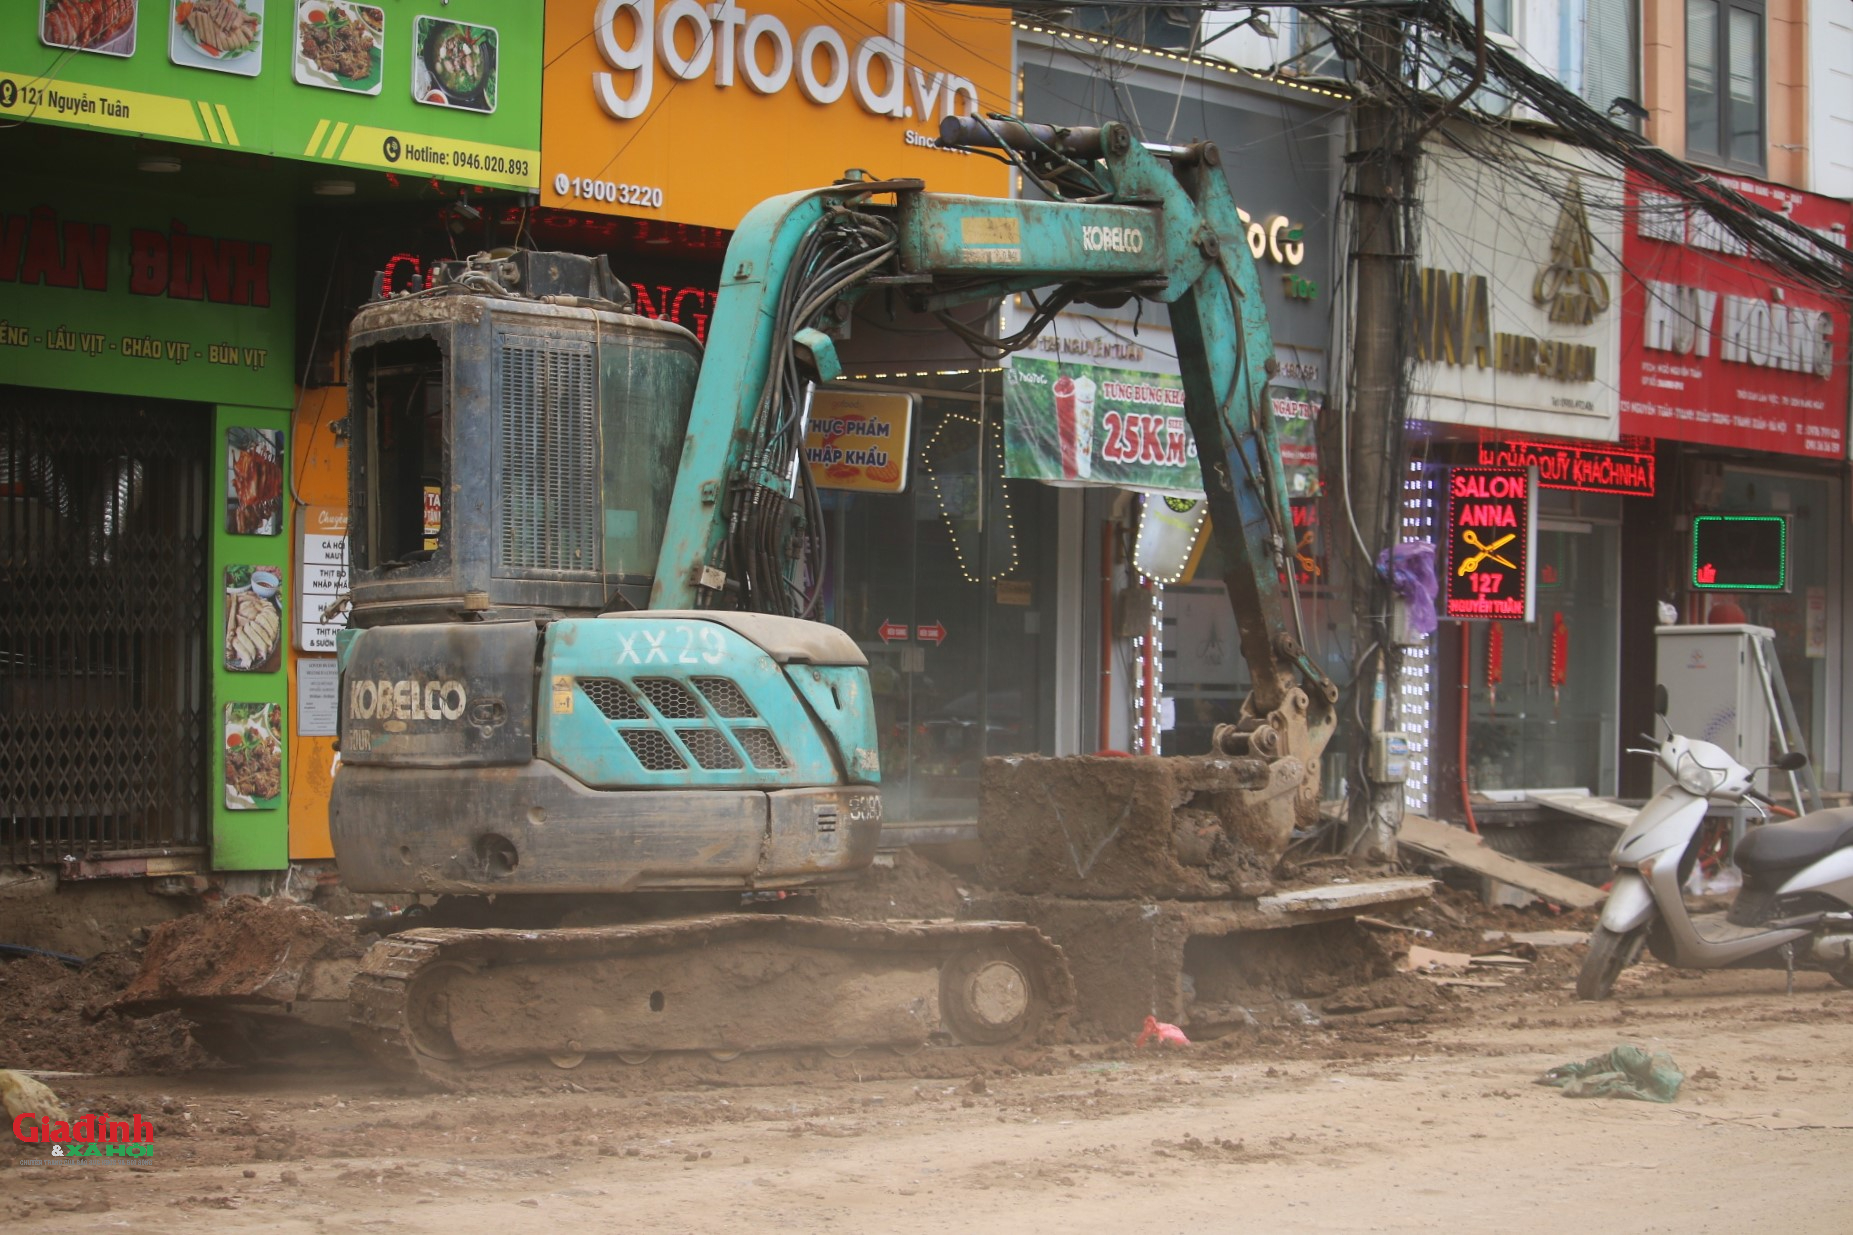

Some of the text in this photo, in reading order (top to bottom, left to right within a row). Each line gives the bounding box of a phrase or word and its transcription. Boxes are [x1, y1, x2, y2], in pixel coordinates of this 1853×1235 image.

[21, 87, 130, 118] 121 Nguyễn Tuân
[405, 144, 529, 176] Hotline: 0946.020.893
[571, 176, 664, 208] 1900 3220
[1082, 225, 1144, 253] KOBELCO
[81, 335, 105, 357] VỊT
[122, 336, 162, 359] CHÁO
[167, 342, 190, 365] VỊT
[208, 343, 239, 365] BÚN
[244, 348, 267, 371] VỊT
[846, 416, 889, 437] PHẨM
[1103, 411, 1164, 465] 25K
[845, 446, 887, 467] KHẨU
[1166, 431, 1186, 466] M
[1454, 476, 1524, 498] SALON
[1459, 503, 1517, 527] ANNA
[1469, 573, 1504, 593] 127
[351, 680, 467, 721] KOBELCO
